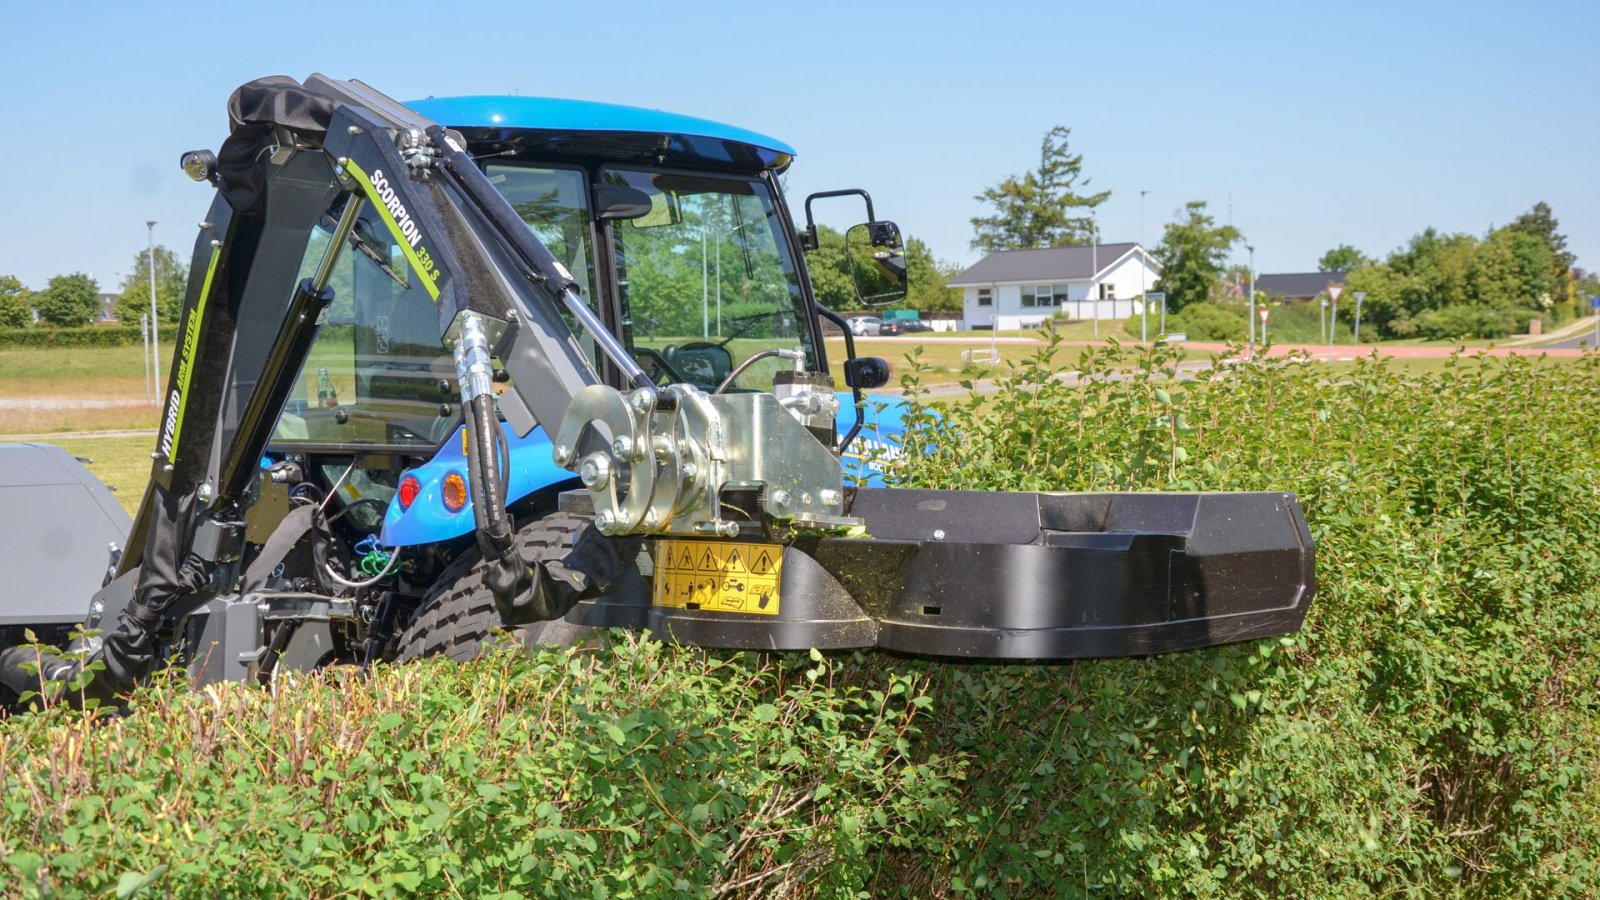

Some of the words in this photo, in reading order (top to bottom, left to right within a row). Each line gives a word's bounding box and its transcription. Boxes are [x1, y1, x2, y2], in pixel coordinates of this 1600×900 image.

[370, 169, 423, 248] SCORPION
[416, 246, 434, 271] 330
[430, 269, 440, 281] S
[182, 308, 197, 359] SYSTEM
[176, 358, 189, 391] ARM
[161, 389, 181, 458] HYBRID
